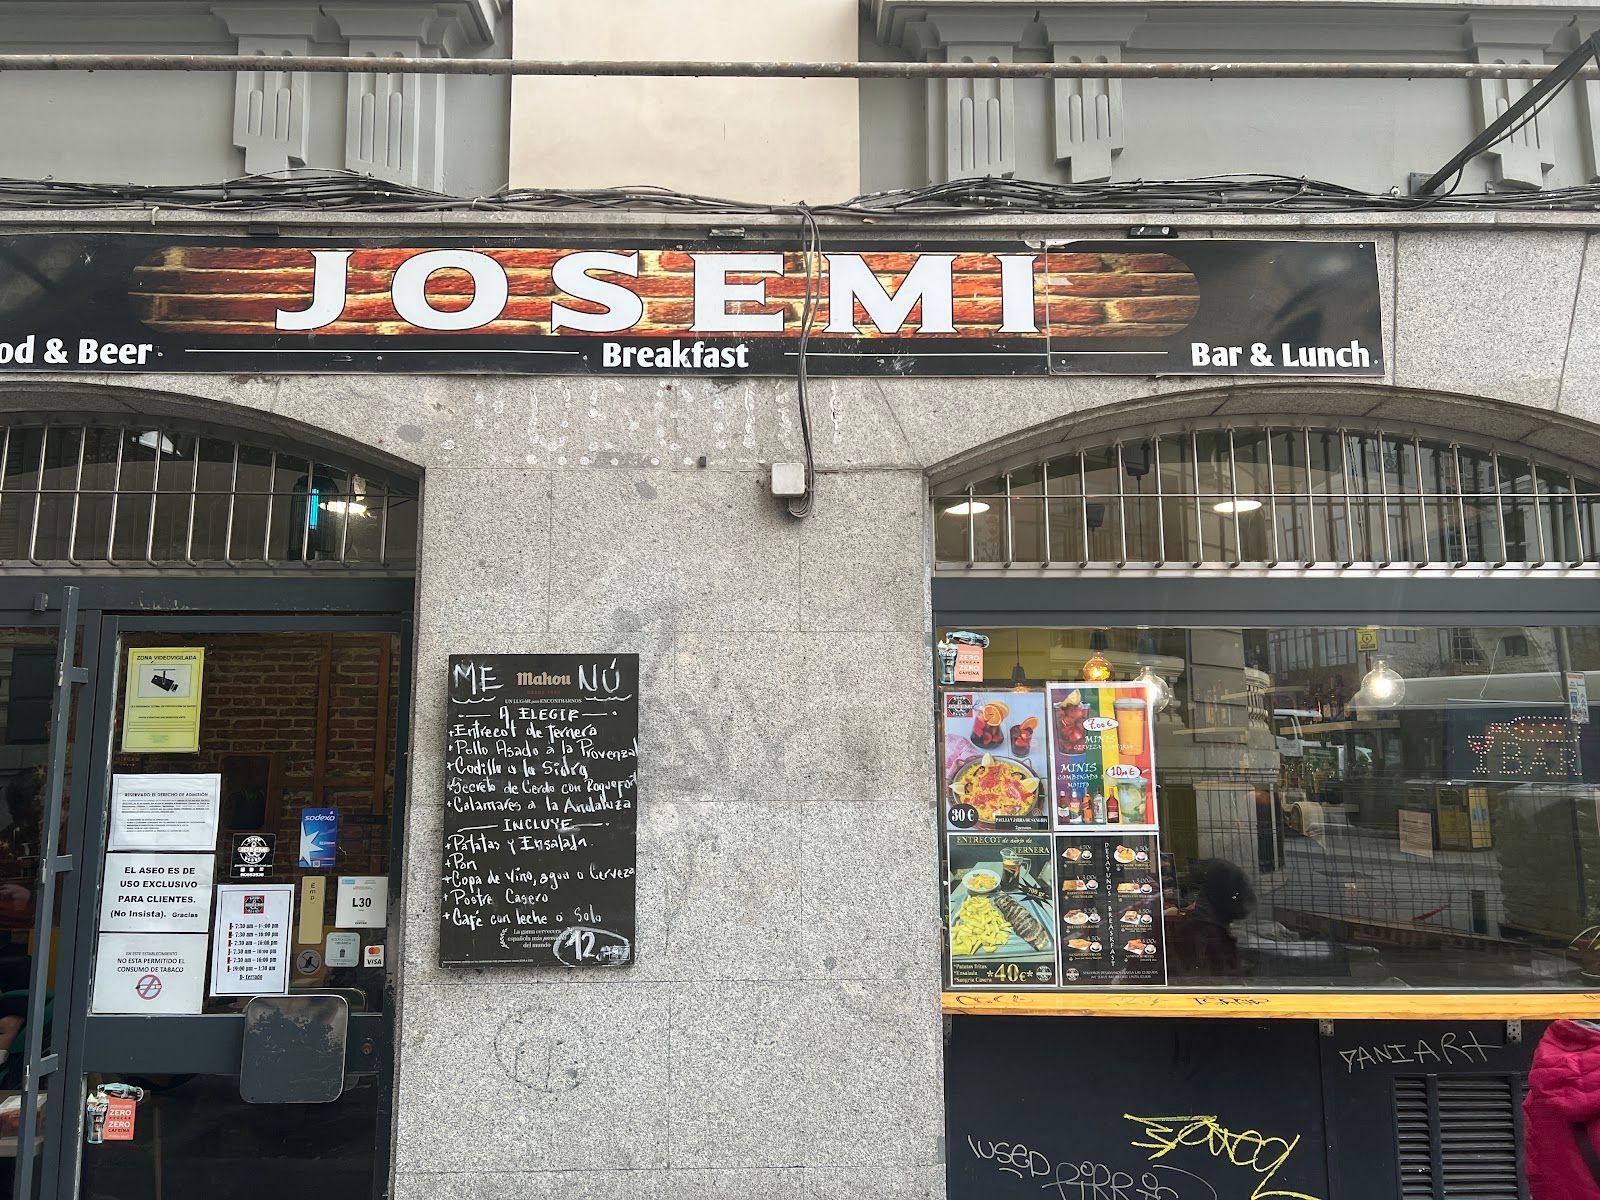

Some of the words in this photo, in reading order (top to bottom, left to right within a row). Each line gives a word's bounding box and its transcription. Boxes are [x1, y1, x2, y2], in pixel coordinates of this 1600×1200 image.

[275, 248, 1041, 335] JOSEMI
[43, 337, 69, 364] &
[78, 338, 153, 365] Beer
[602, 338, 750, 370] Breakfast
[1191, 342, 1242, 367] Bar
[1250, 342, 1275, 367] &
[1281, 339, 1370, 368] Lunch
[516, 671, 572, 686] Mahou
[526, 722, 543, 738] de
[496, 740, 539, 757] Asado
[562, 740, 574, 754] la
[1500, 742, 1582, 776] BAR
[523, 759, 536, 777] la
[1060, 763, 1097, 773] MINIS
[504, 781, 519, 794] de
[522, 779, 555, 794] Cerdo
[561, 783, 581, 793] con
[546, 796, 559, 812] la
[305, 812, 336, 821] sodexo
[951, 809, 966, 822] 30
[967, 809, 975, 822] €
[503, 818, 573, 832] INCLUYE
[487, 870, 500, 885] de
[589, 863, 635, 880] Cerveza
[352, 898, 372, 907] L30
[505, 889, 549, 905] Casero
[110, 910, 126, 918] (No
[129, 910, 166, 919] Insista).
[490, 913, 511, 926] con
[516, 908, 548, 925] leche
